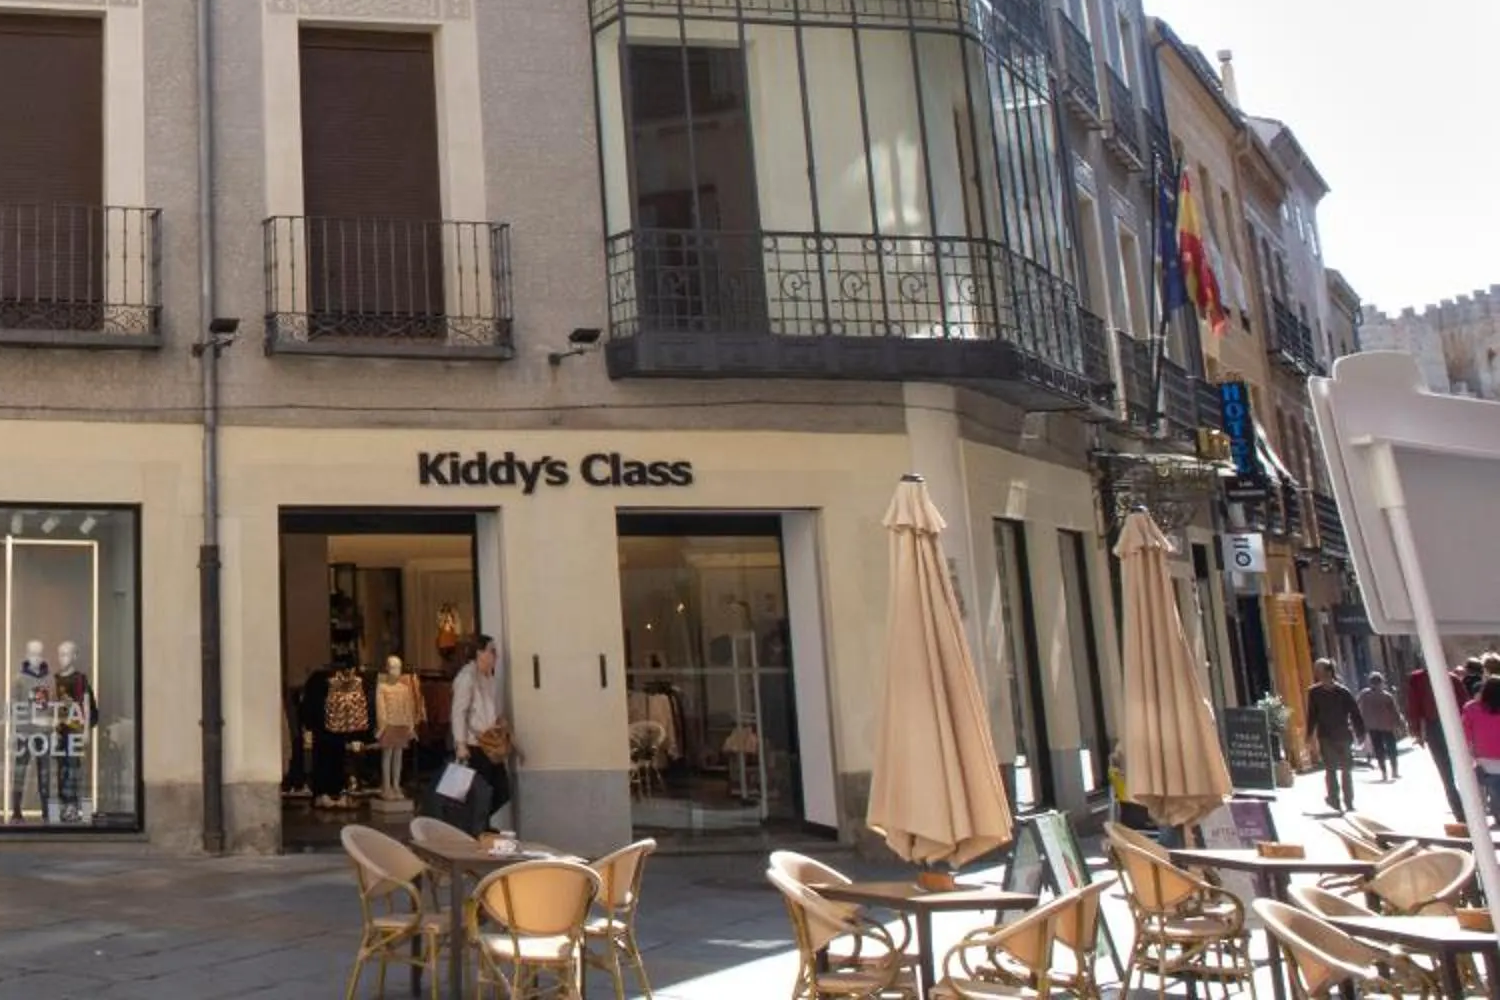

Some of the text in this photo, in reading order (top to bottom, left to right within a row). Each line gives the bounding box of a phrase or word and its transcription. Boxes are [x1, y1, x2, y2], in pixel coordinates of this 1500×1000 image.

[418, 452, 693, 494] Kiddy's Class
[9, 732, 85, 757] COLE
